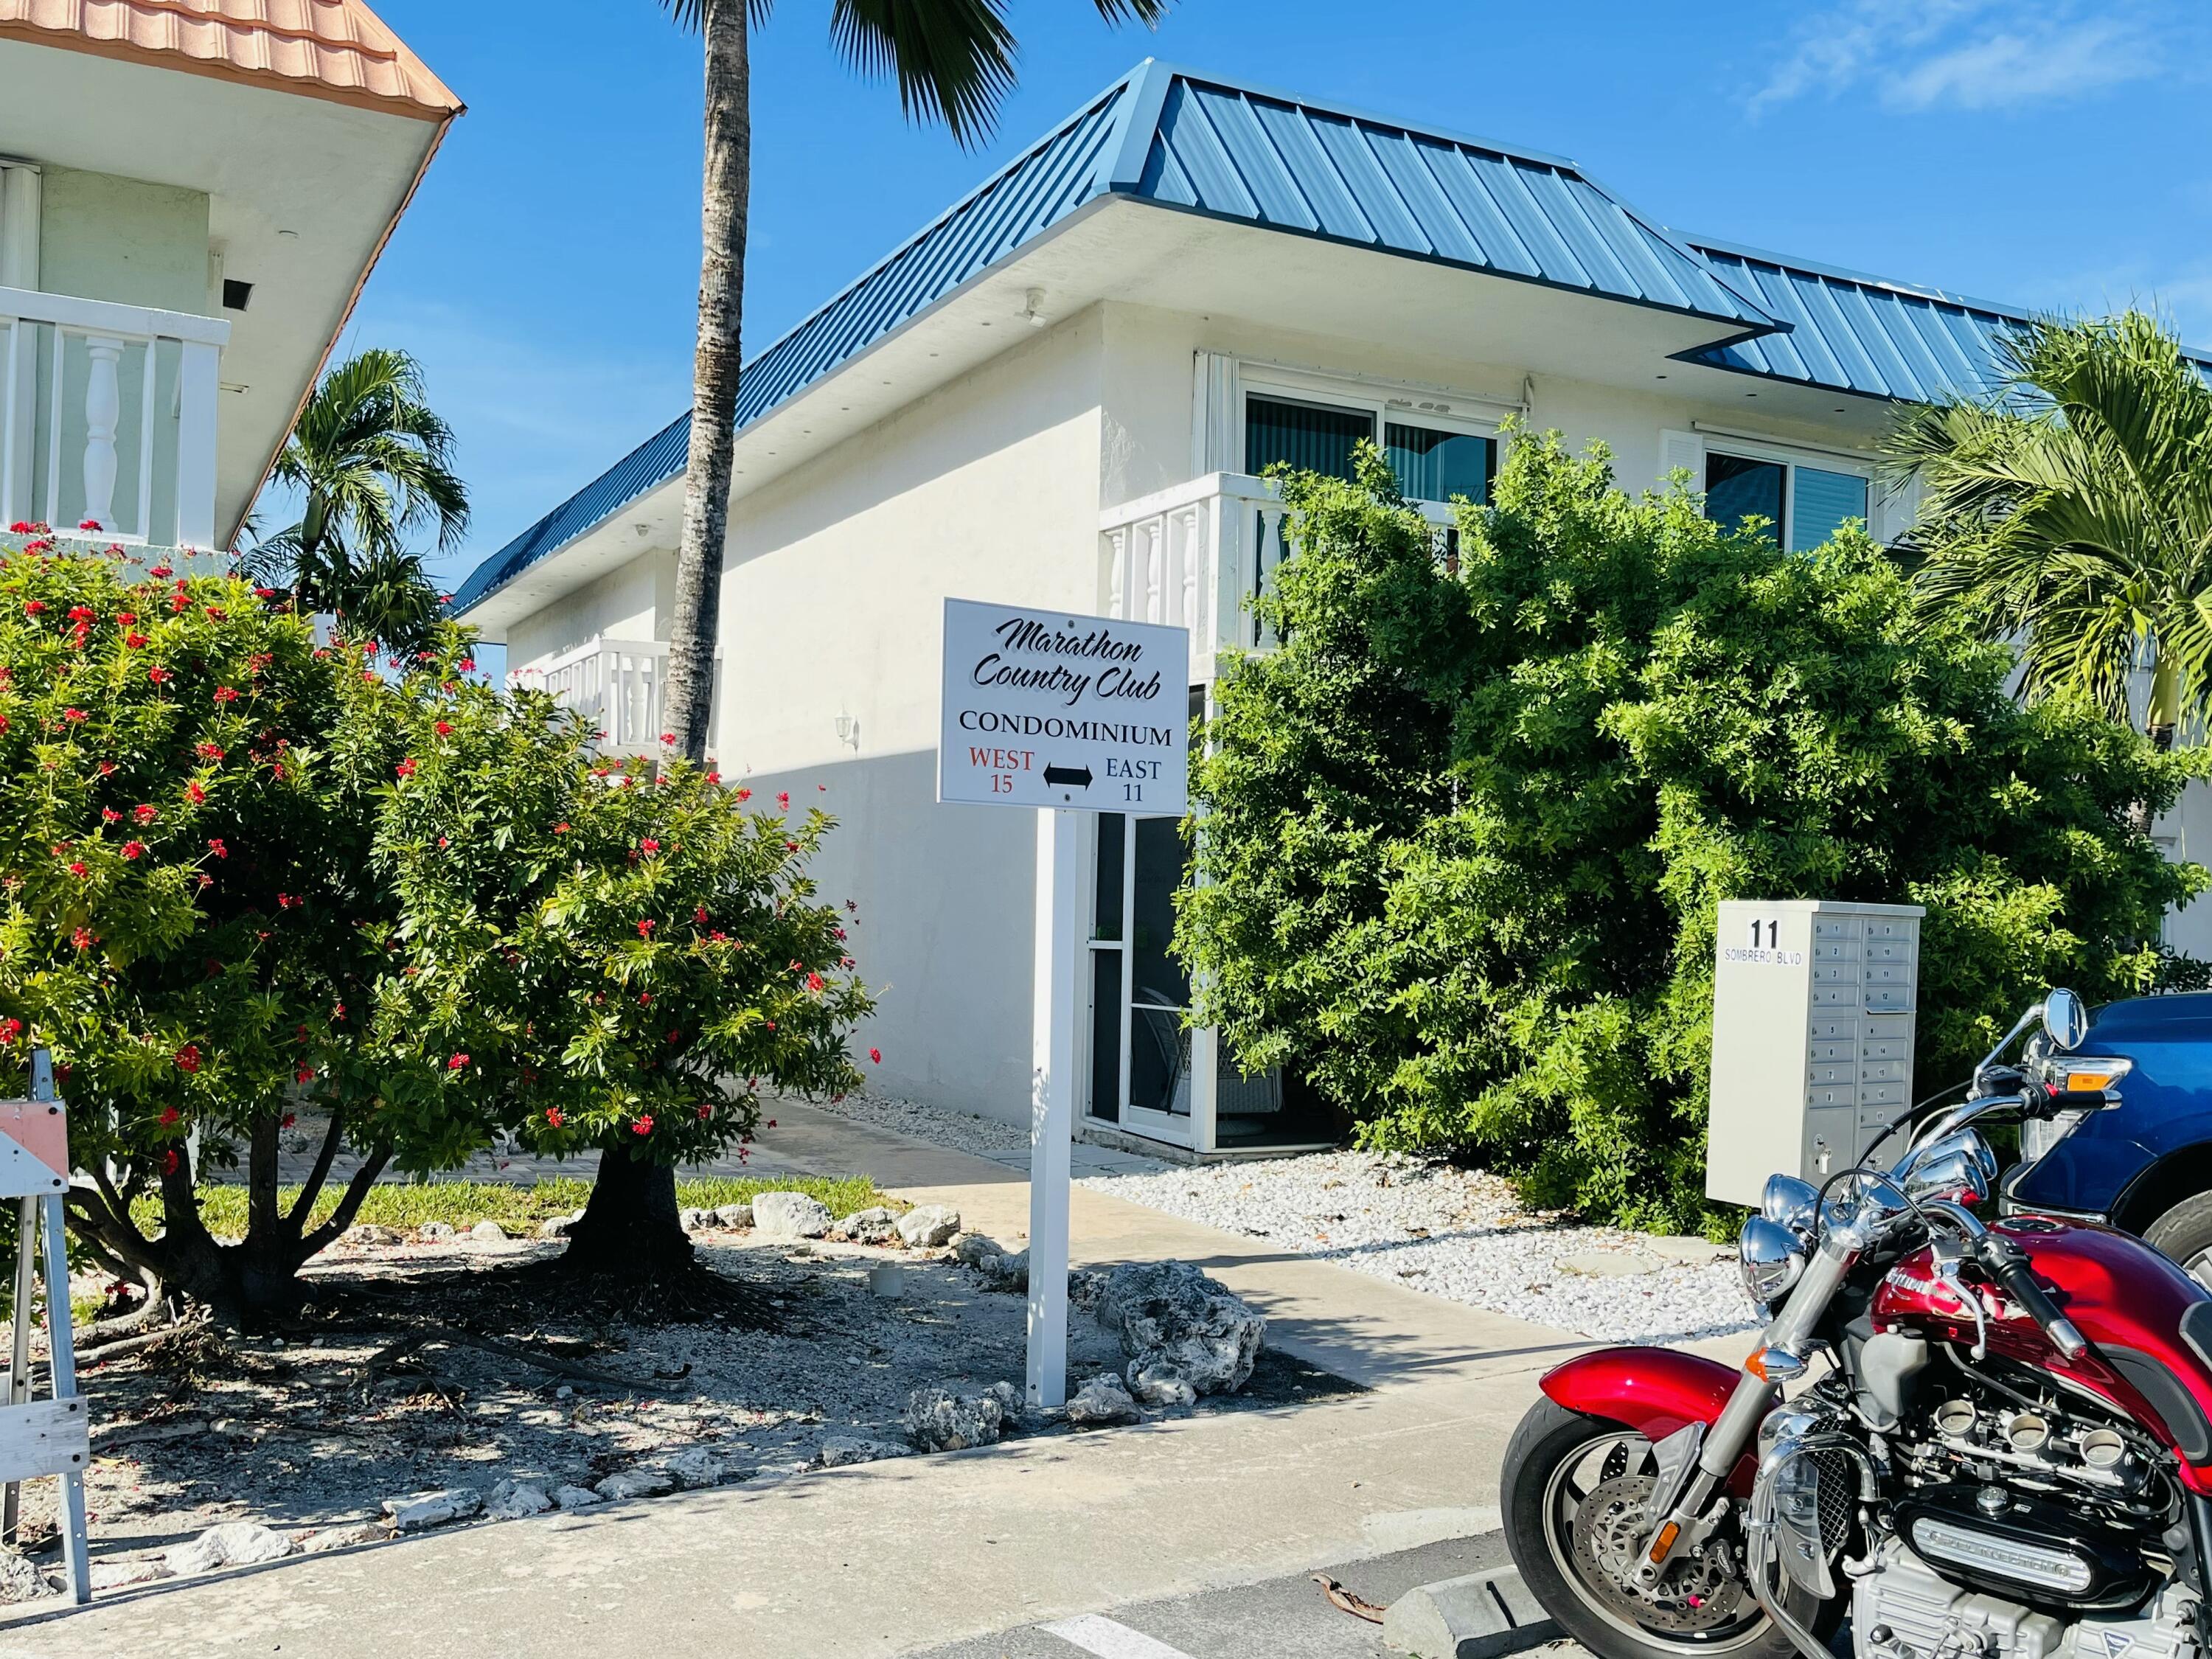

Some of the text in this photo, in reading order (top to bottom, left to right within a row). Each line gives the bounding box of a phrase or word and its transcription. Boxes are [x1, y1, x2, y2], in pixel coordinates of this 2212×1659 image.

[995, 618, 1143, 663] Marathon
[973, 653, 1162, 706] Country Club
[959, 710, 1172, 747] CONDOMINIUM
[968, 746, 1034, 771] WEST
[1106, 757, 1162, 780] EAST
[991, 773, 1013, 794] 15
[1123, 783, 1143, 802] 11
[1751, 919, 1778, 949] 11
[1725, 948, 1801, 965] SOMBRERO BLVD
